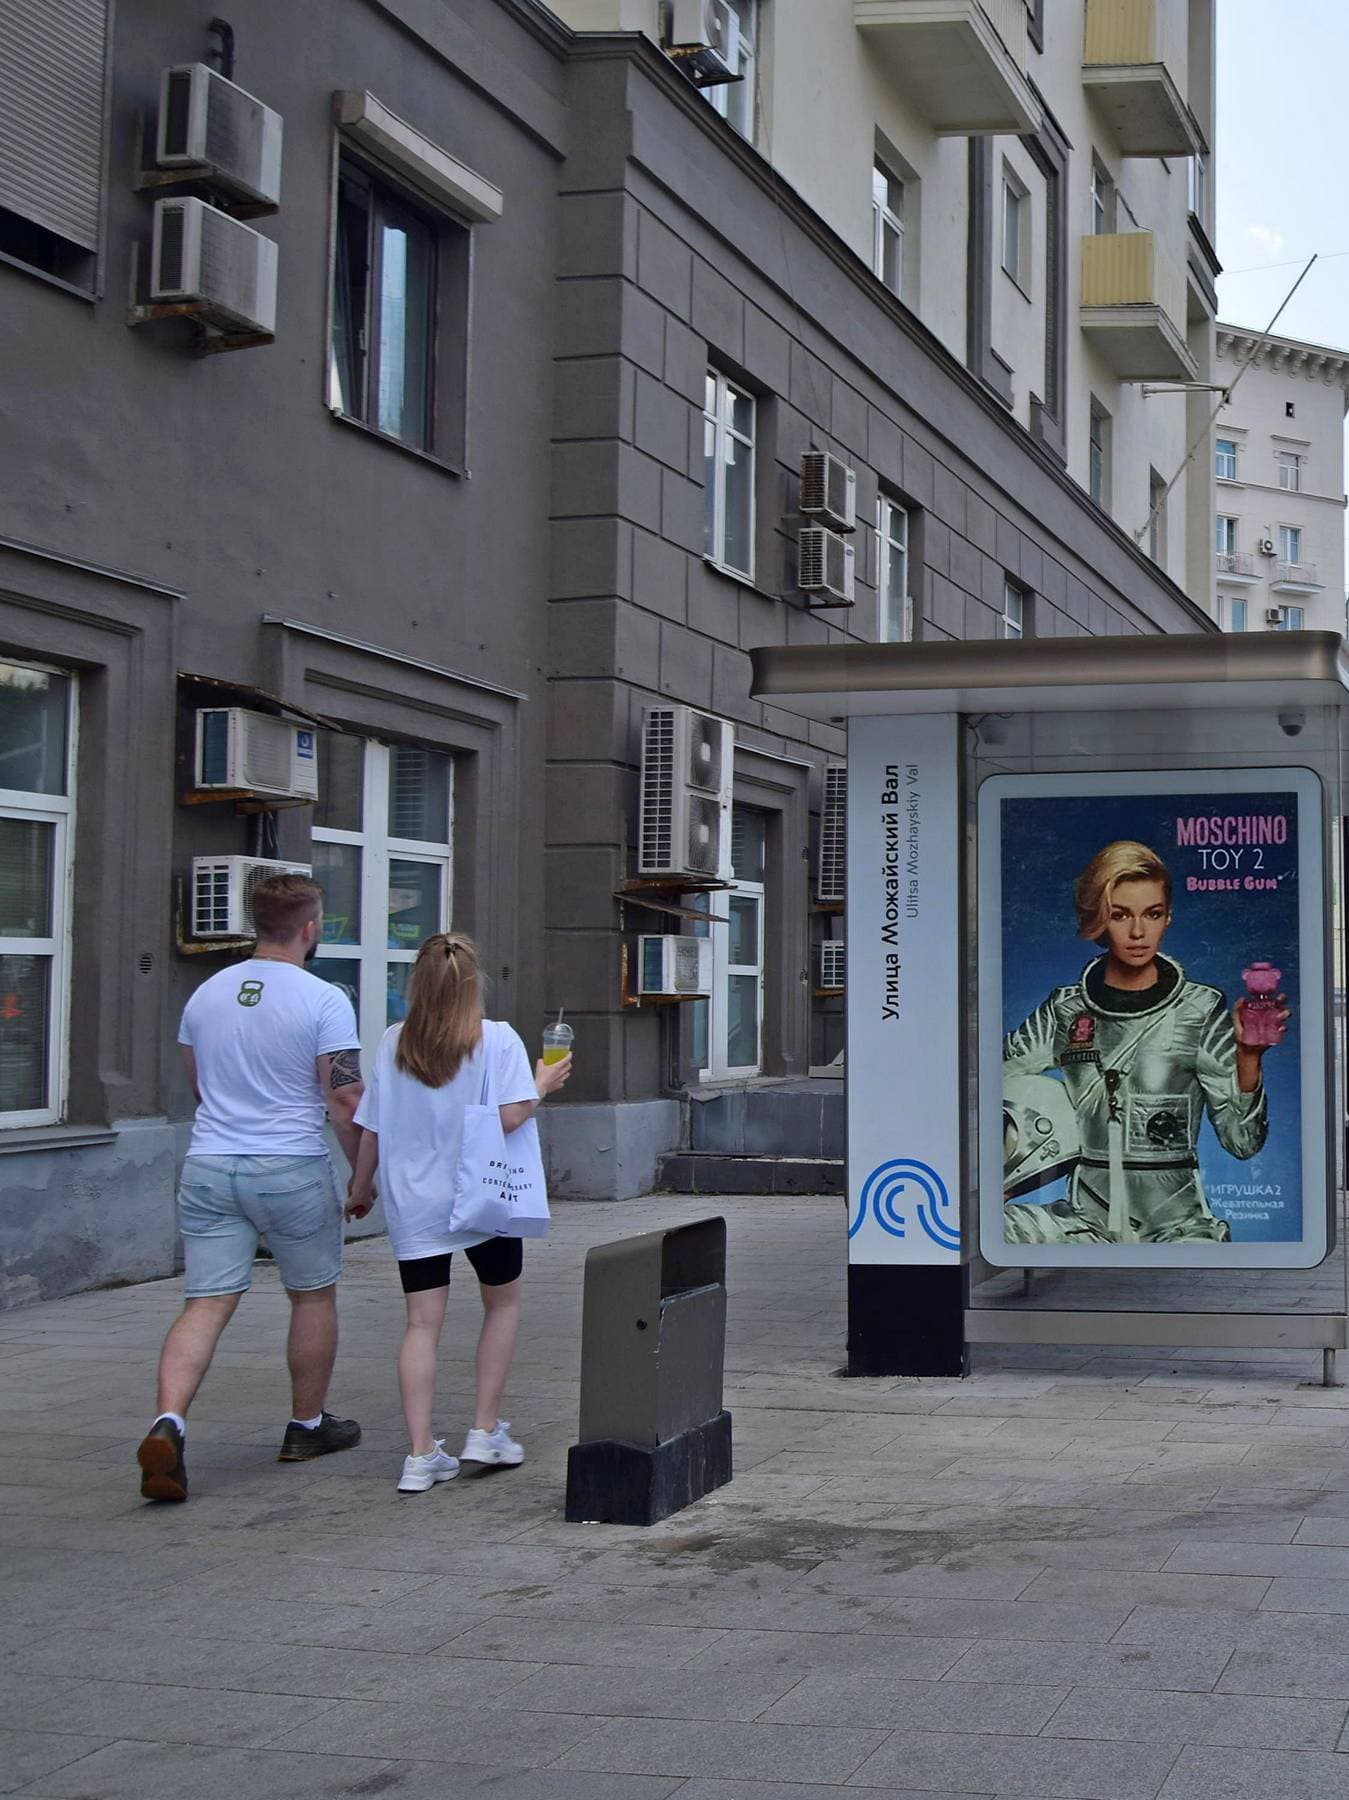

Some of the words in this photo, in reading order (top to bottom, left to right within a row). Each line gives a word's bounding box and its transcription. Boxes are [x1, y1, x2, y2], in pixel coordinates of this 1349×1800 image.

[881, 764, 899, 804] Вал
[905, 764, 919, 786] Val
[906, 791, 921, 875] Mozhayskiy
[1176, 815, 1287, 846] MOSCHINO
[1198, 849, 1244, 870] TOY
[1252, 848, 1265, 869] 2
[880, 813, 899, 946] Можайский
[906, 879, 919, 918] Ulitsa
[881, 953, 901, 1020] Улица
[1210, 1198, 1285, 1208] Жевательная
[1275, 1184, 1281, 1195] 2
[1225, 1208, 1270, 1220] Резинка
